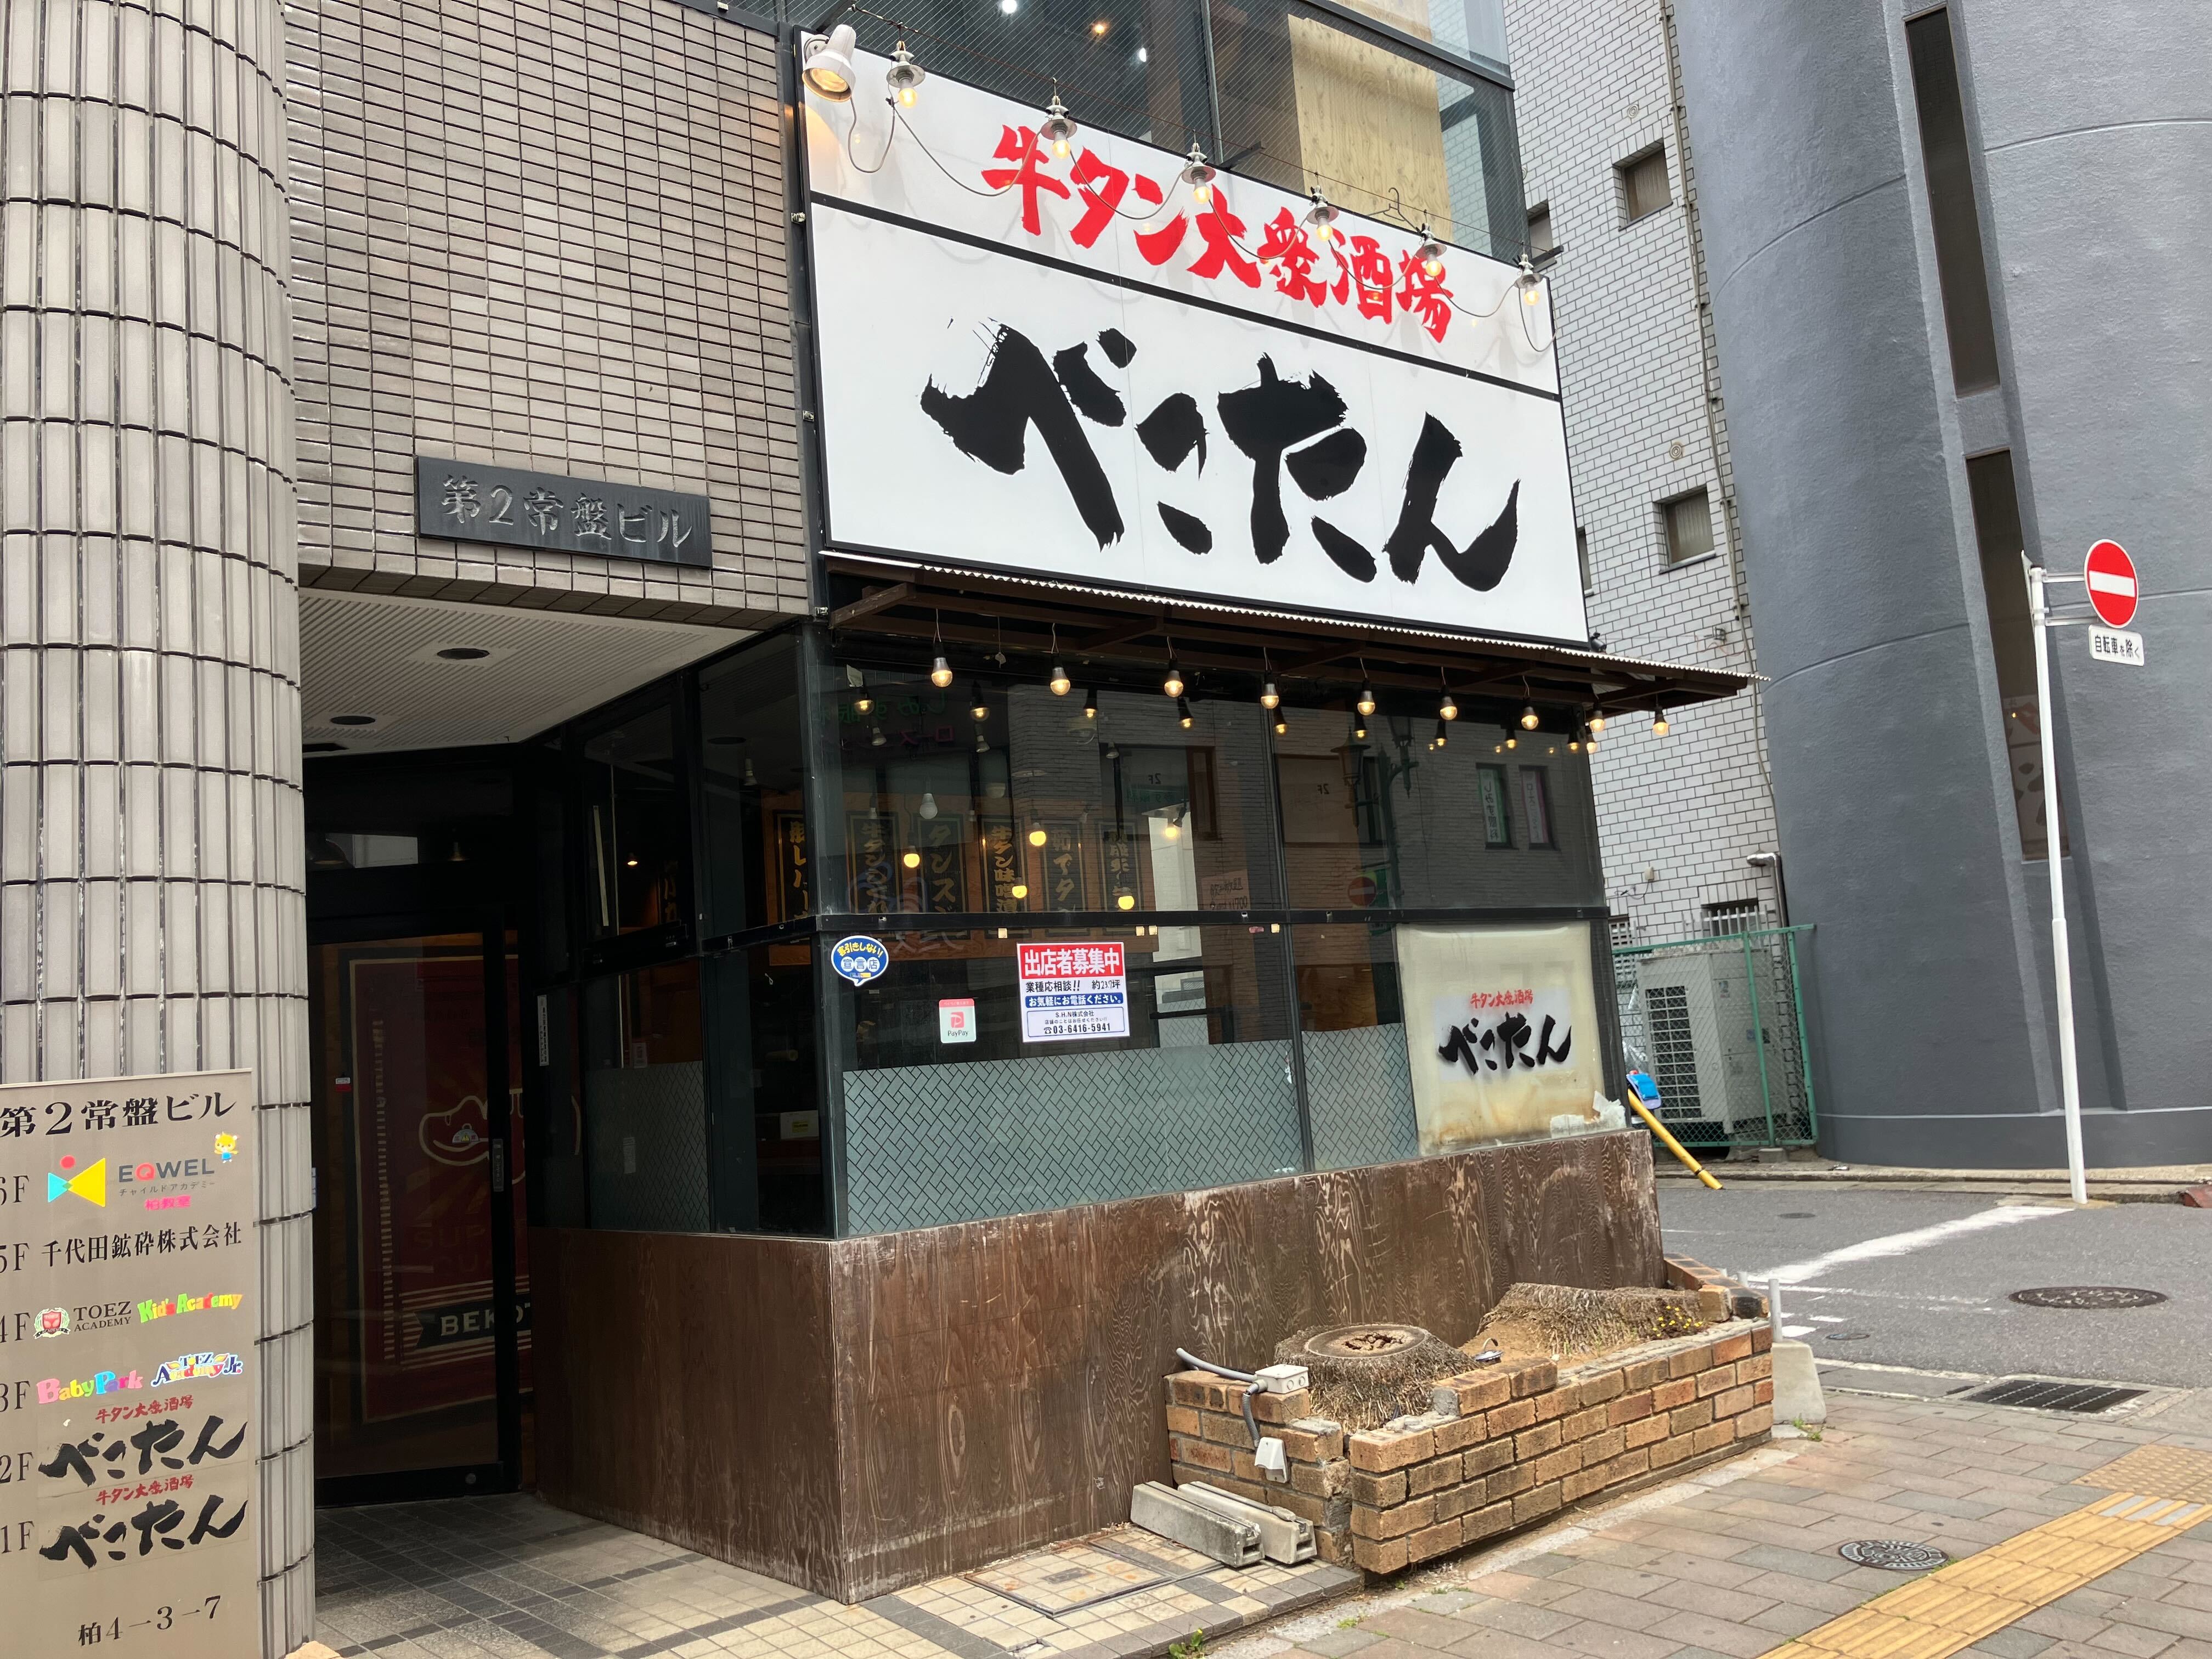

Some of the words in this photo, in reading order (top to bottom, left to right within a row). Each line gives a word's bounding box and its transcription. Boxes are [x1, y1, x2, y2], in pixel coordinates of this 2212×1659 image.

[981, 124, 1454, 343] 牛タン大衆酒場
[920, 317, 1521, 592] べこたん
[441, 474, 692, 548] 第2常盤ビル
[2095, 634, 2140, 658] 自転車を除く
[1024, 947, 1119, 976] 出店者募集中
[1029, 995, 1121, 1007] お気軽にお電話ください。
[1470, 989, 1534, 1008] 牛タン大衆酒場
[1053, 1023, 1111, 1034] 03-6416-5941
[1438, 1012, 1572, 1075] べこたん
[0, 1092, 236, 1137] 第2常盤ビル
[119, 1159, 215, 1183] EQWEL
[119, 1182, 215, 1197] チャイルドアカデミー
[41, 1222, 242, 1268] 千代田鉱砕株式会社
[74, 1301, 132, 1322] TOEZ
[74, 1316, 131, 1331] ACADEMY
[0, 1381, 31, 1413] 3F
[95, 1395, 194, 1423] 牛タン大衆酒場
[0, 1452, 34, 1483] 2F
[38, 1415, 248, 1487] べこたん
[95, 1474, 194, 1505] 牛タン大衆酒場
[1, 1521, 34, 1554] 1F
[39, 1494, 248, 1569] べこたん
